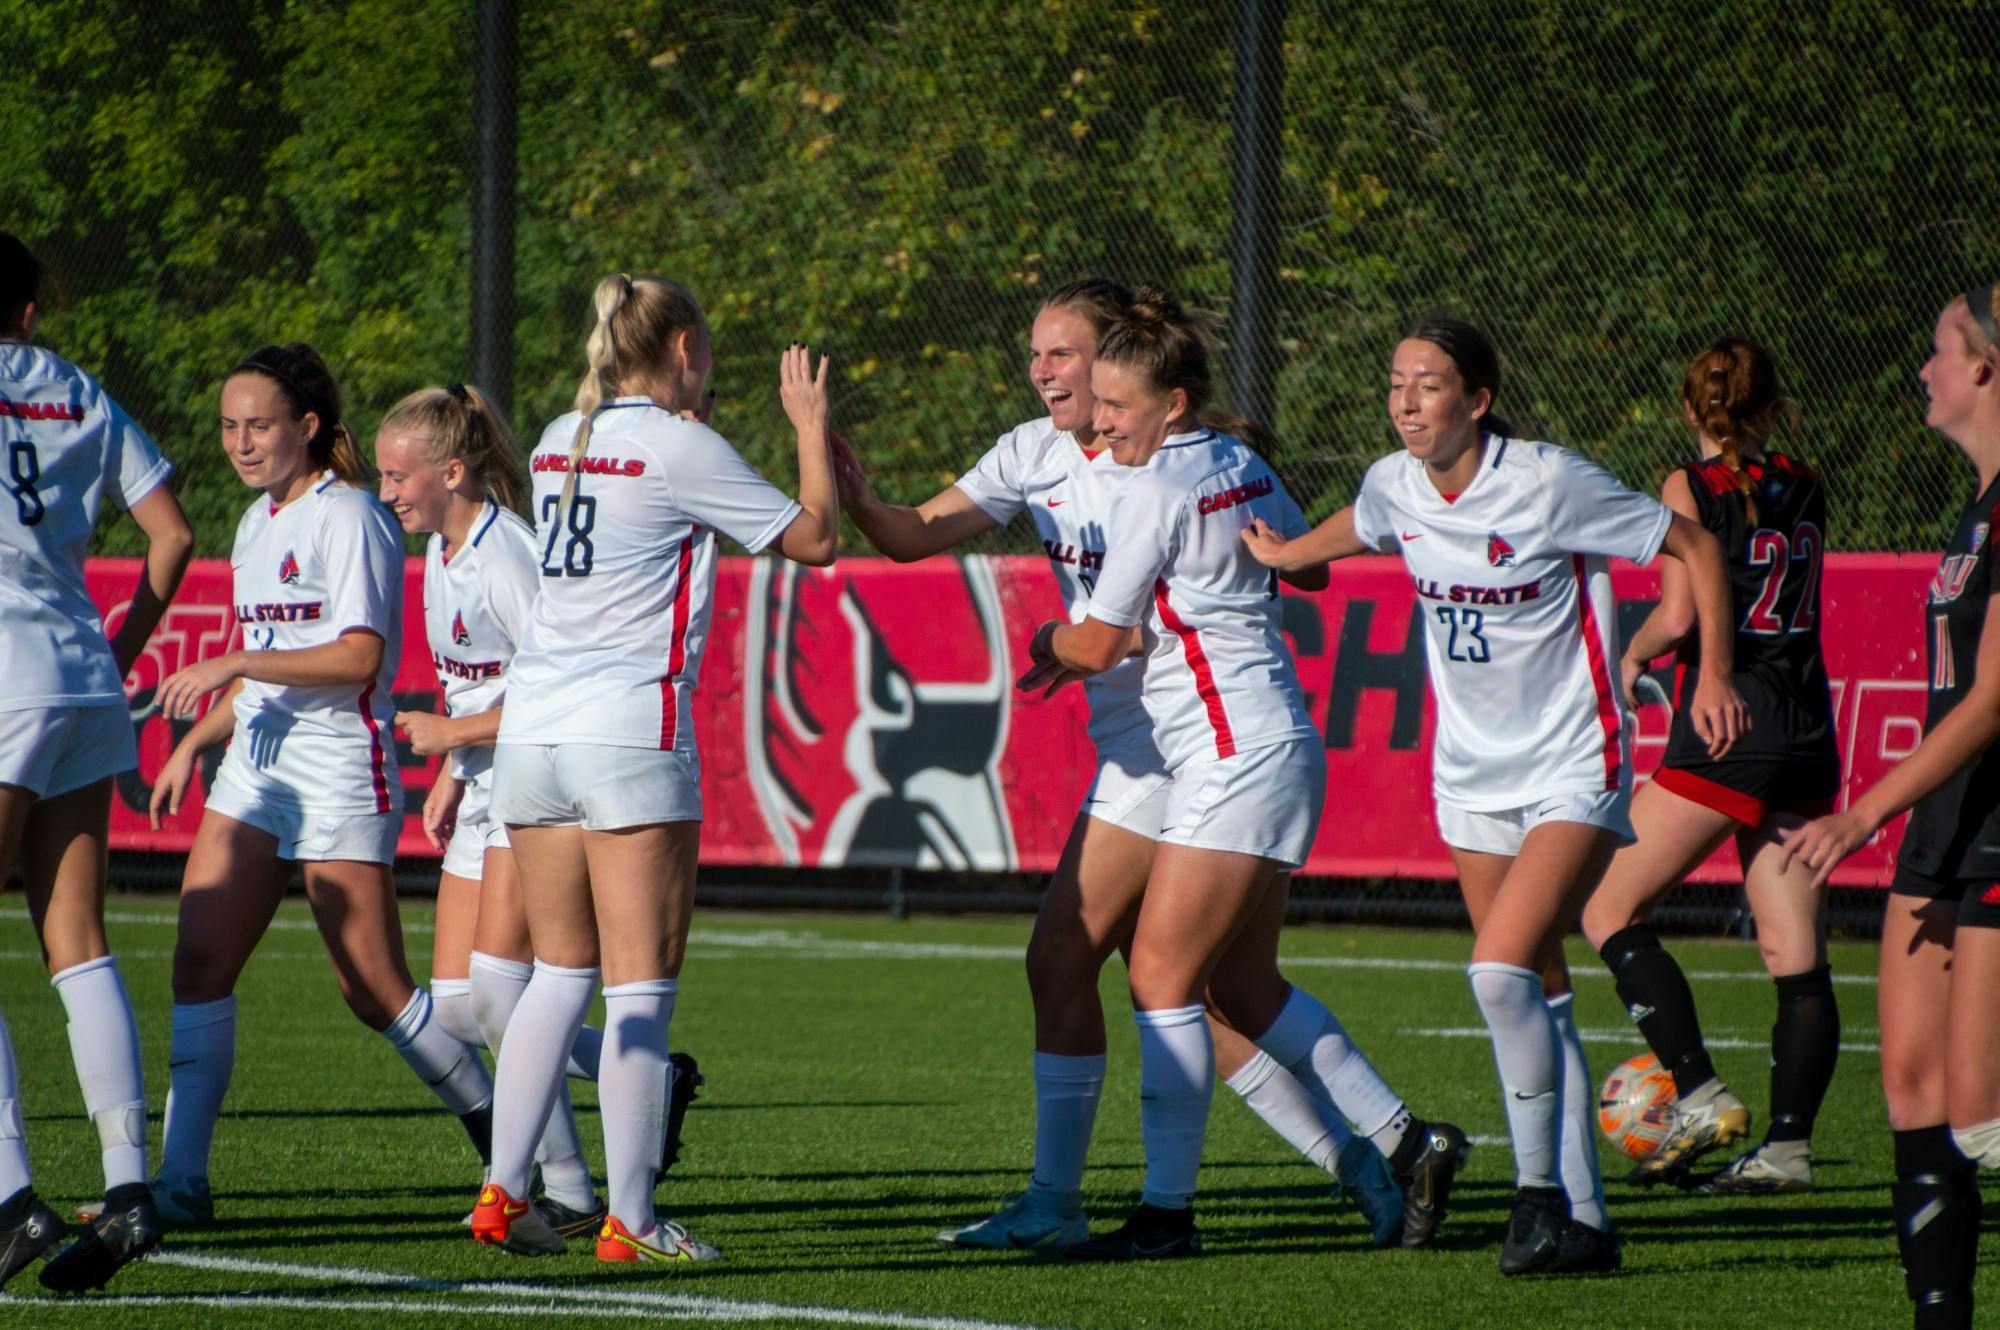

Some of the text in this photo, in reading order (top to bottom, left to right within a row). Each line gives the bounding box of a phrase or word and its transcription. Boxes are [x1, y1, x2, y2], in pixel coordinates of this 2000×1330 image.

[9, 441, 44, 526] 8
[541, 494, 597, 577] 28
[1448, 579, 1542, 605] STATE
[1741, 521, 1821, 634] 22
[255, 601, 322, 622] STATE
[1436, 606, 1491, 663] 23
[443, 655, 502, 681] STATE
